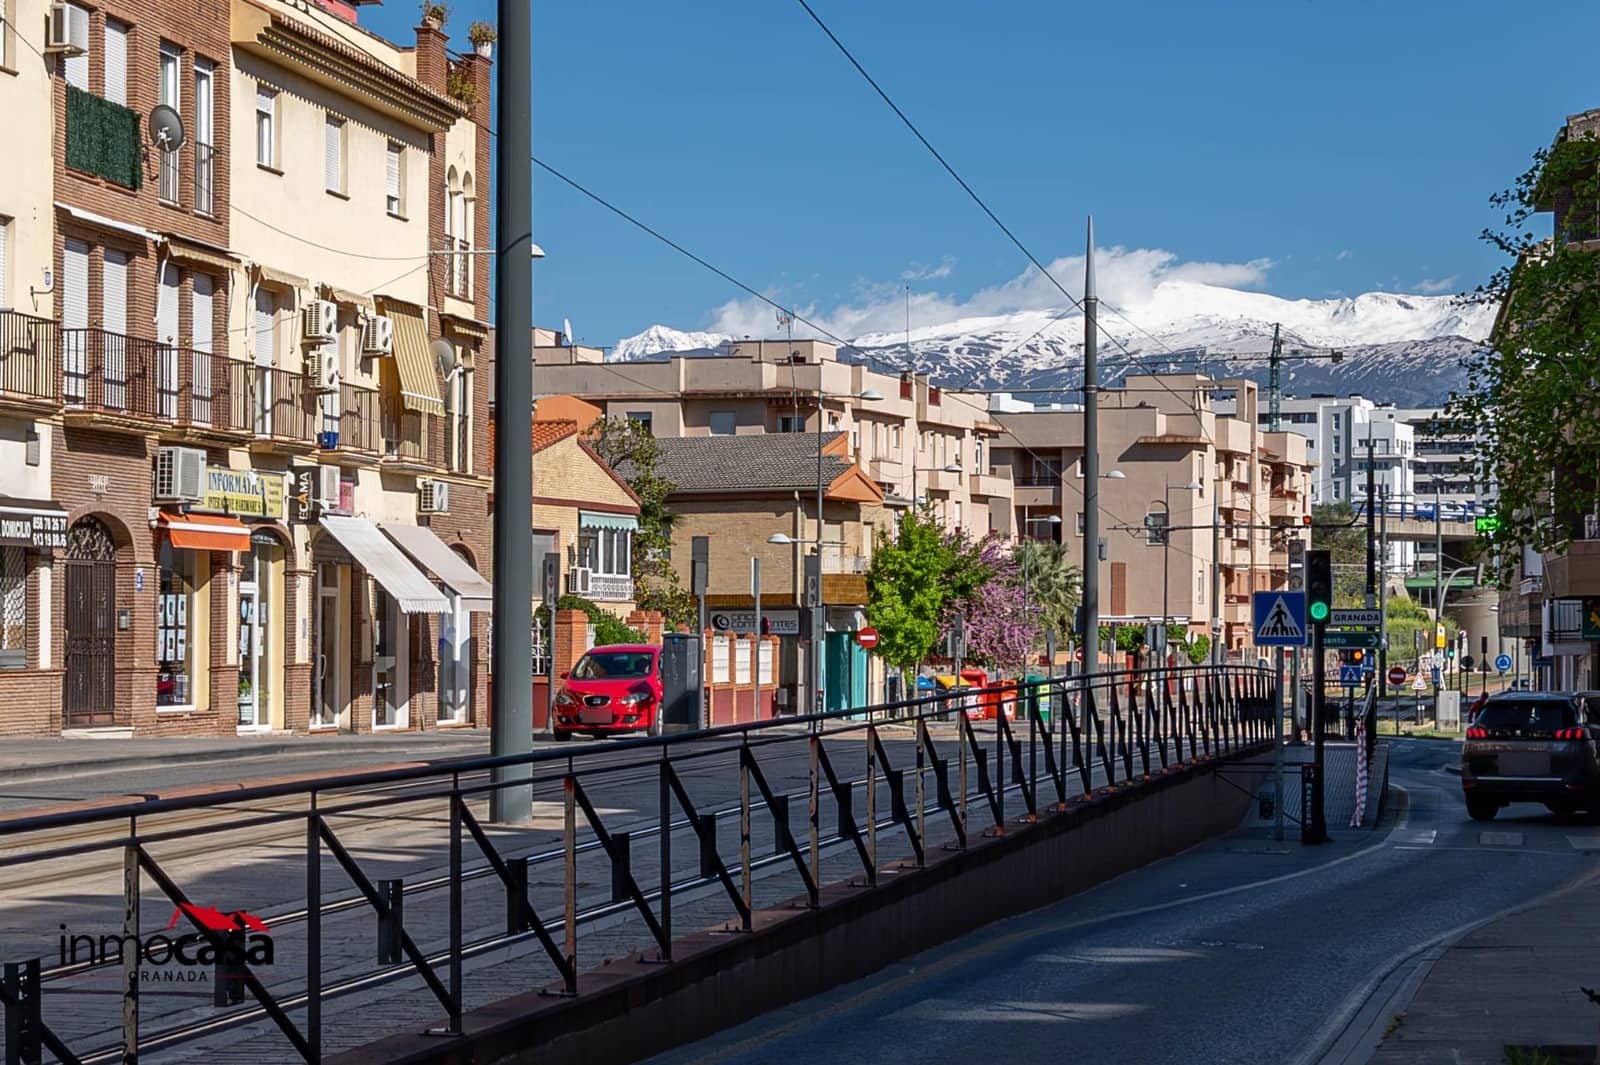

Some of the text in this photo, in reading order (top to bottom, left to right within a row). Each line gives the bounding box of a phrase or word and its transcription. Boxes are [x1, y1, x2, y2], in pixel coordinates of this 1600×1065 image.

[299, 472, 309, 520] ECAMA
[1, 519, 32, 538] DOMICILIO
[731, 613, 757, 621] CINC
[1334, 614, 1379, 622] GRANADA
